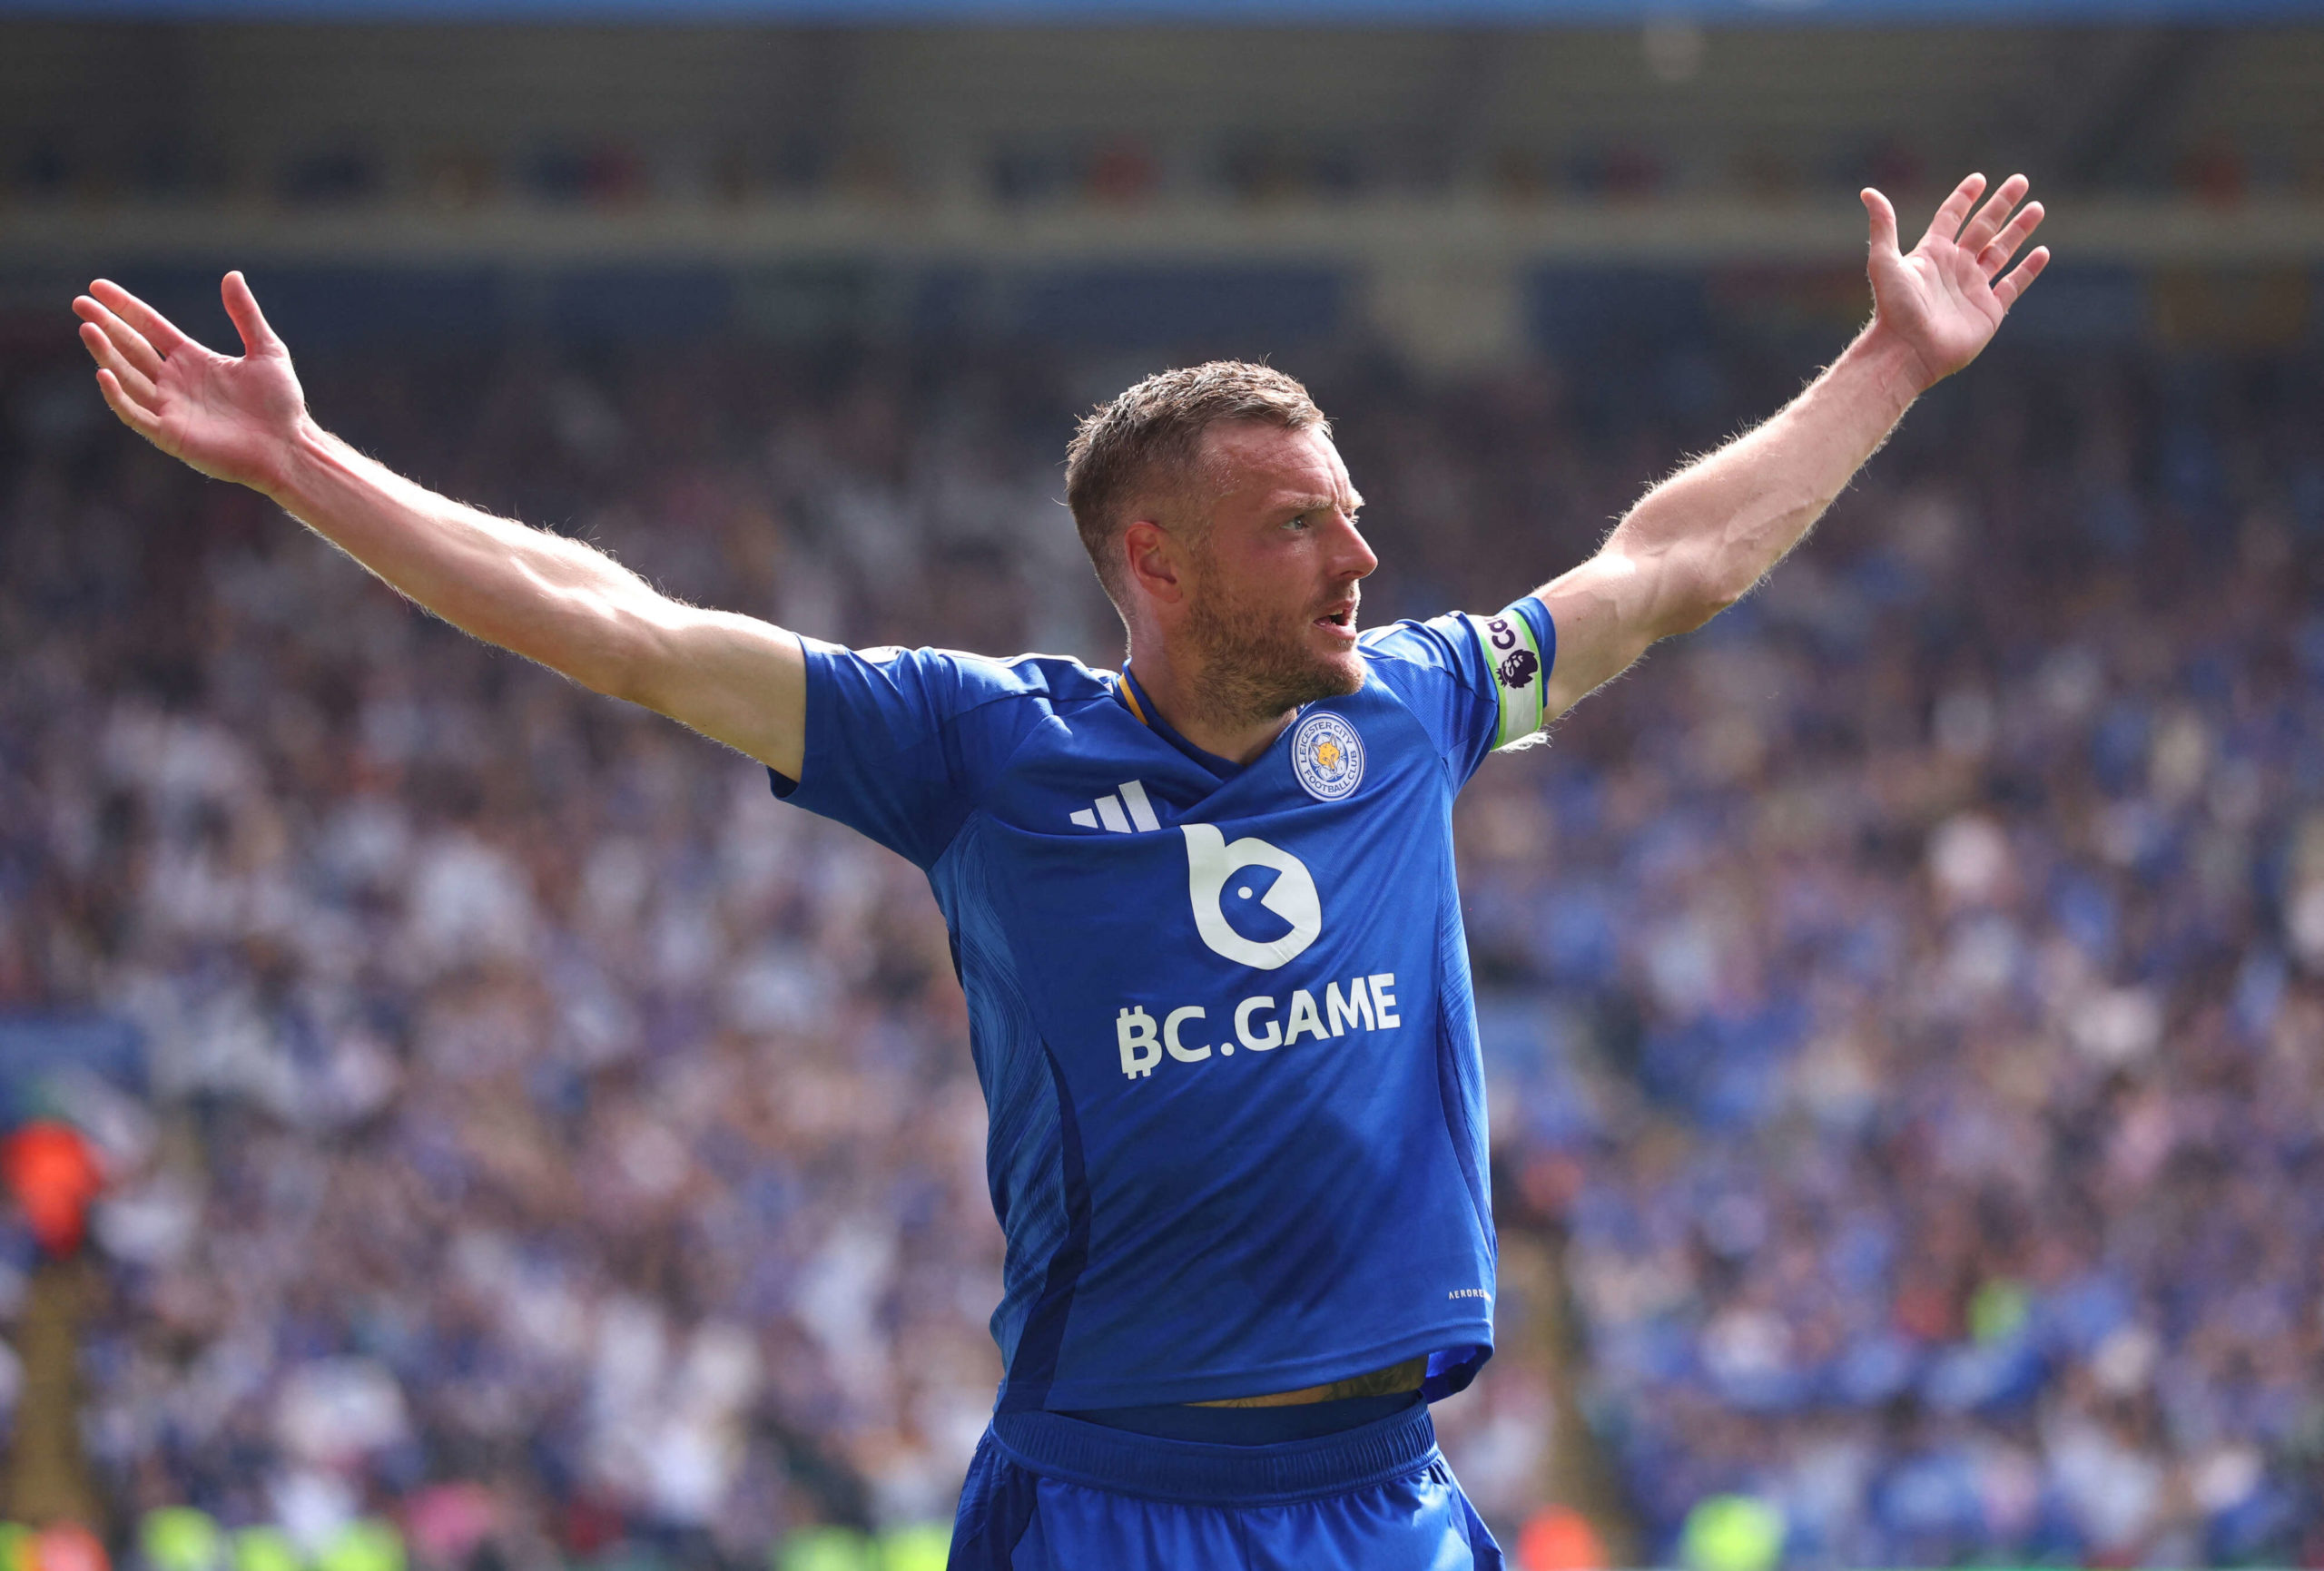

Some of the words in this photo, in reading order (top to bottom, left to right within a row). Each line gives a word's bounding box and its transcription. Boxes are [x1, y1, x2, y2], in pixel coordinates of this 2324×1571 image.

[1487, 619, 1516, 650] Ca
[1300, 722, 1332, 763] LEICESTER
[1334, 724, 1353, 745] CITY
[1304, 769, 1350, 793] FOOTBALL
[1347, 750, 1357, 781] CLUB
[1448, 1288, 1492, 1302] AERORE
